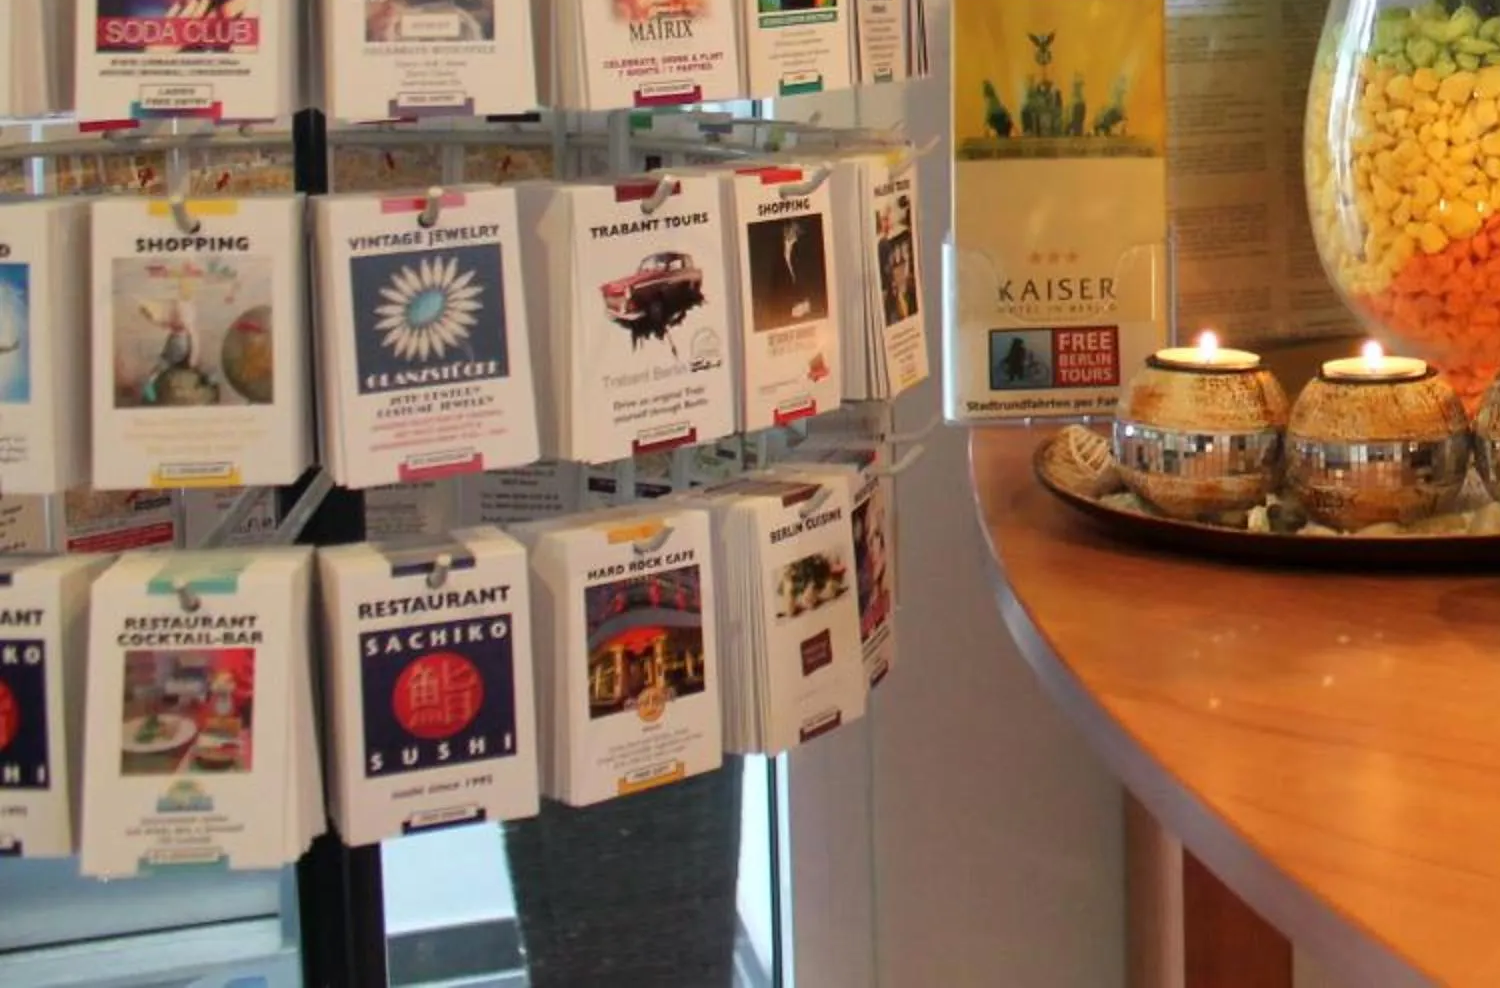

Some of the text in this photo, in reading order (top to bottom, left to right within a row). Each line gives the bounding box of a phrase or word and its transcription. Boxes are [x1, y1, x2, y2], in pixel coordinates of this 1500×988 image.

[105, 20, 251, 43] SODA CLUB
[629, 16, 694, 43] MATRIX
[757, 197, 811, 217] SHOPPING
[348, 223, 501, 251] VINTAGE JEWELRY
[590, 211, 710, 240] TRABANT TOURS
[135, 236, 250, 253] SHOPPING
[997, 277, 1117, 302] KAISER
[1058, 331, 1112, 352] FREE
[1058, 352, 1112, 368] BERLIN
[1059, 367, 1113, 383] TOURS
[966, 399, 1070, 412] Stadtrundfahrten
[769, 508, 842, 545] BERLIN CUISINE
[587, 549, 695, 581] HARD ROCK CAFE
[358, 585, 512, 619] RESTAURANT
[124, 615, 258, 631] RESTAURANT
[117, 631, 264, 647] COCKTAIL-BAR
[364, 620, 509, 657] SACHIKO
[370, 734, 512, 771] SUSHI
